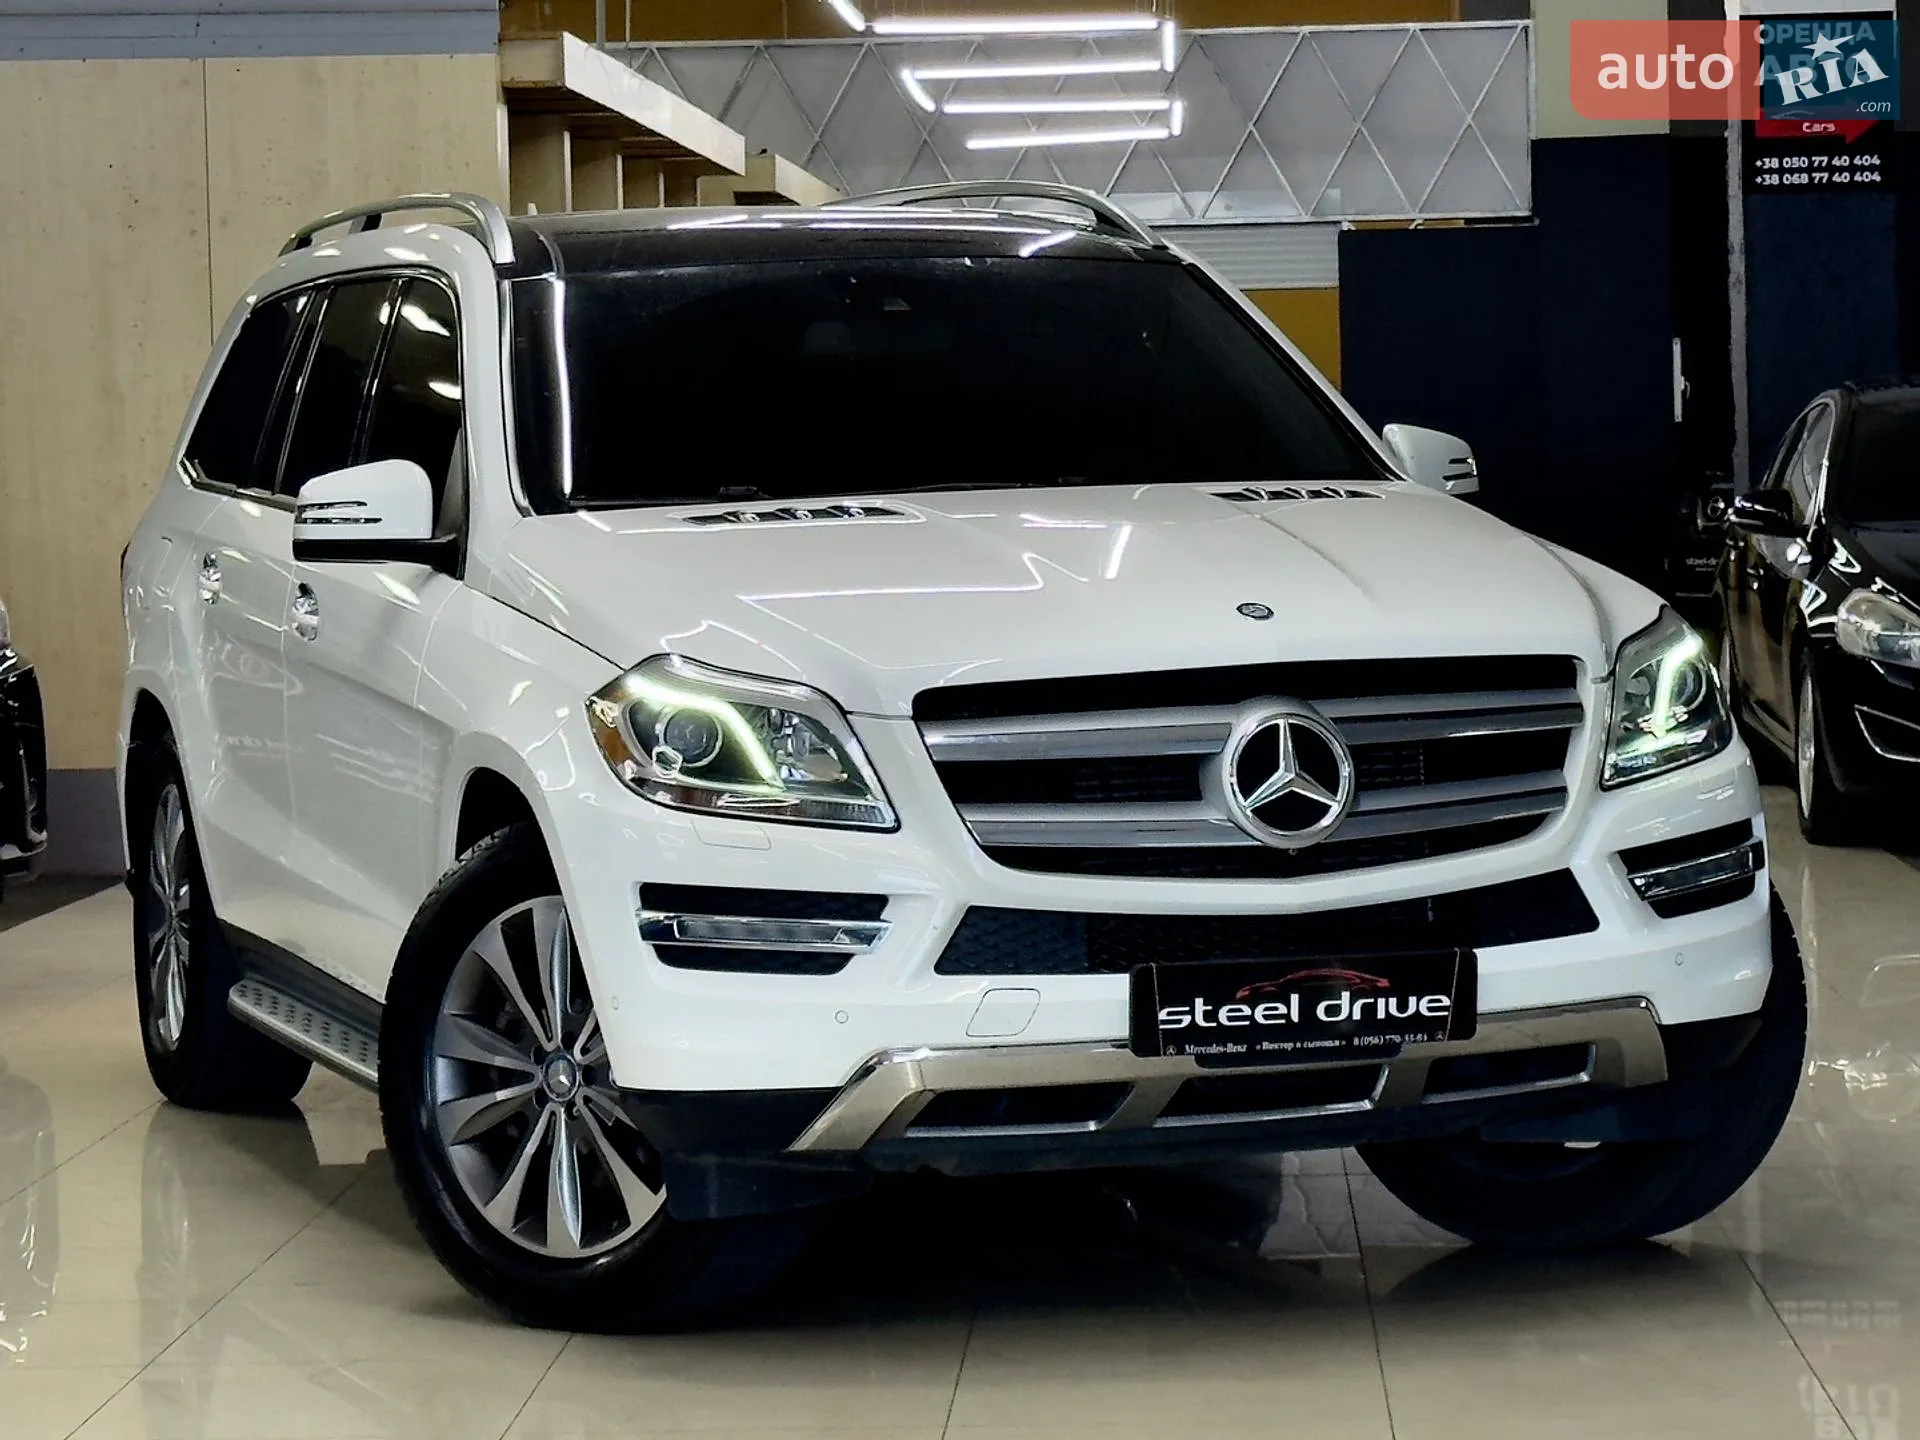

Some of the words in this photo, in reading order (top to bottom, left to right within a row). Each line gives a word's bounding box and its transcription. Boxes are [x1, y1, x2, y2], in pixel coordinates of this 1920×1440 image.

[1755, 158, 1779, 169] +38
[1783, 157, 1808, 168] 050
[1812, 156, 1828, 167] 77
[1832, 156, 1850, 166] 40
[1853, 155, 1881, 166] 404
[1755, 174, 1780, 185] +38
[1783, 173, 1809, 184] 068
[1812, 172, 1829, 183] 77
[1832, 172, 1850, 183] 40
[1854, 171, 1881, 182] 404
[1159, 993, 1299, 1029] steel
[1316, 991, 1451, 1022] drive
